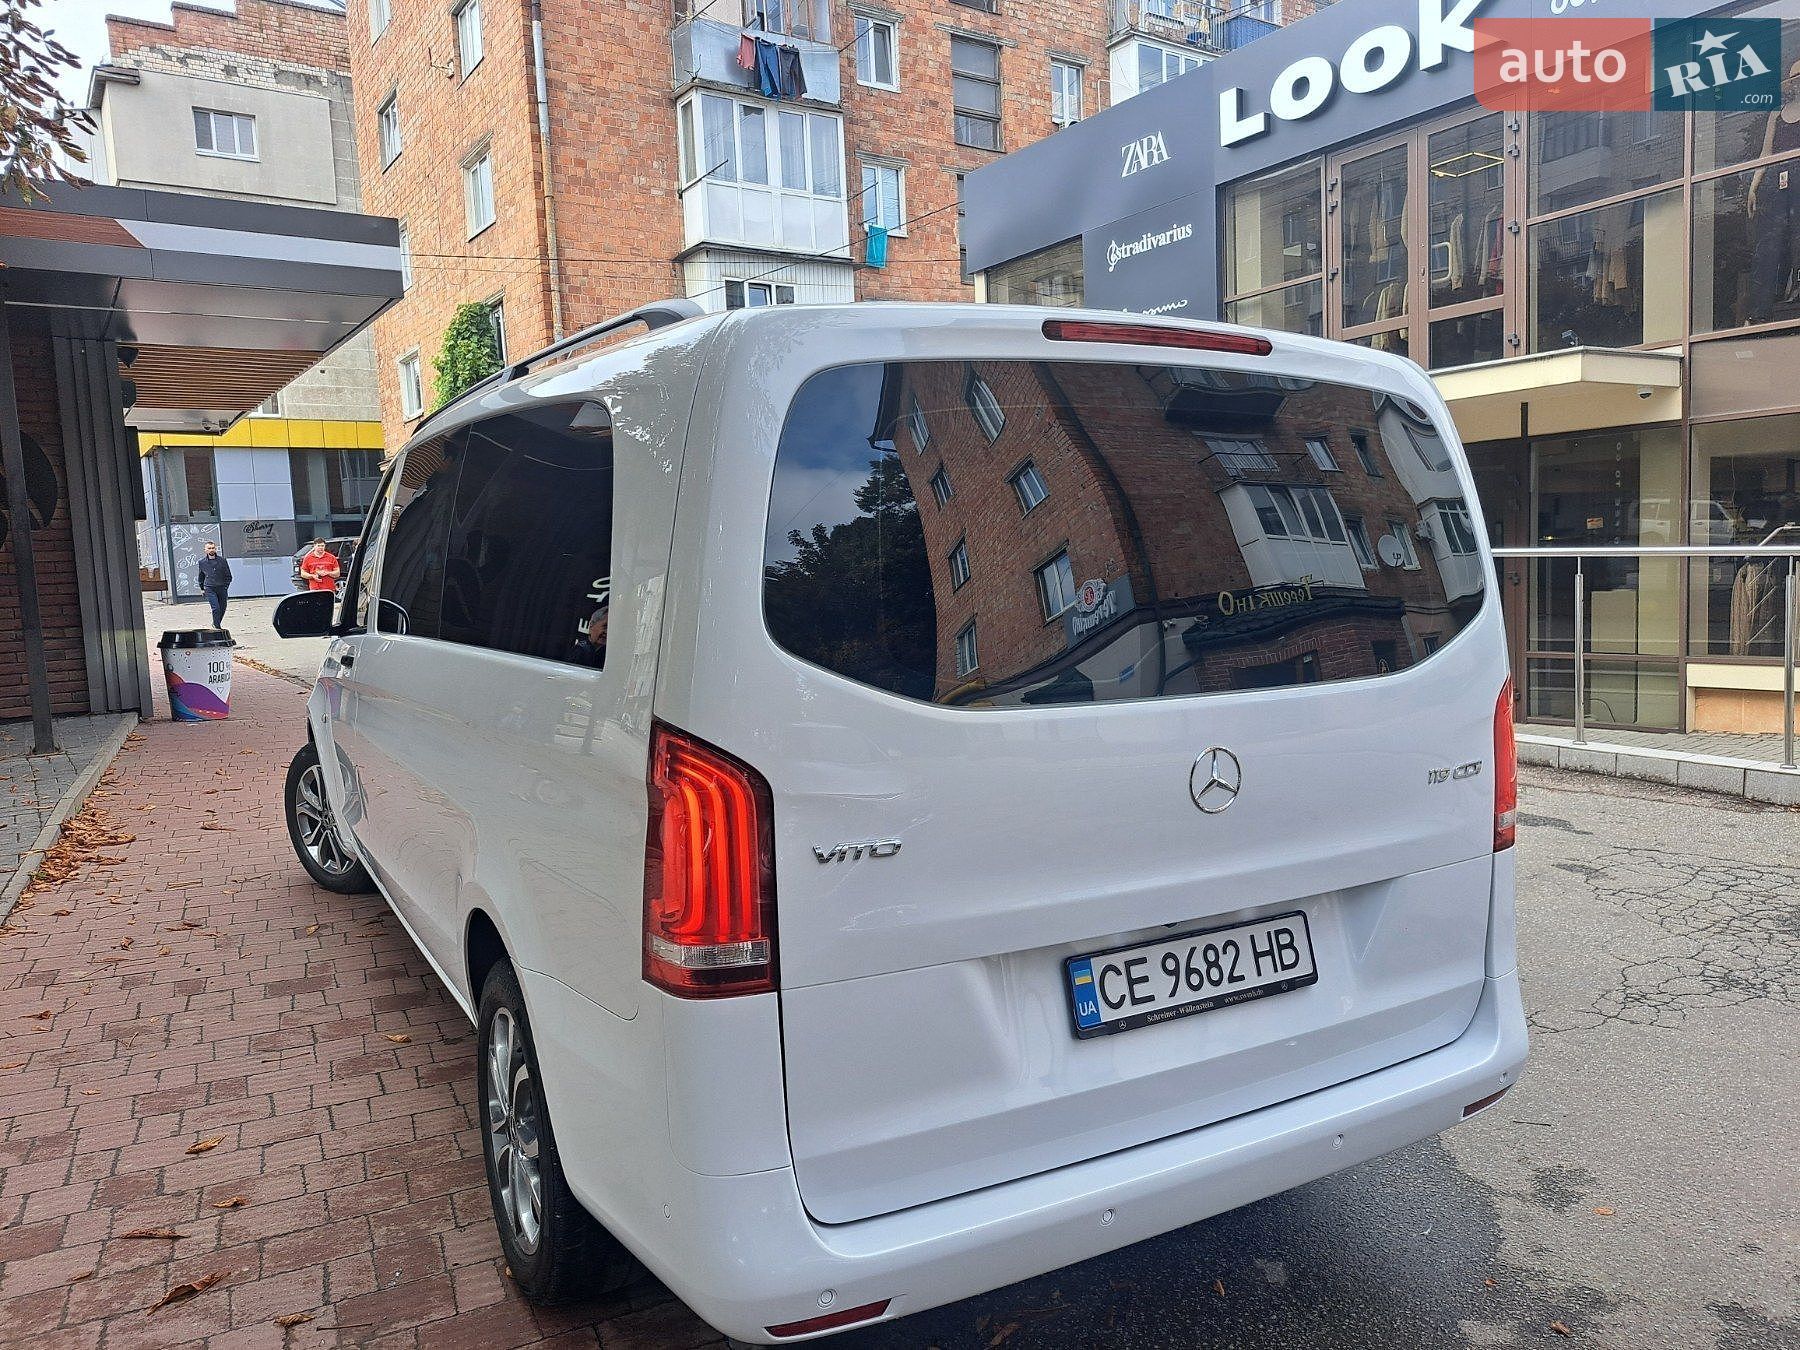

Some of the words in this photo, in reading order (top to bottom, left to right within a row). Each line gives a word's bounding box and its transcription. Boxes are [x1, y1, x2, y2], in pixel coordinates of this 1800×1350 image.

[1219, 0, 1500, 147] LOOK
[1121, 130, 1172, 178] ZARA
[812, 839, 902, 863] VITO
[1099, 957, 1155, 1010] CE
[1161, 940, 1246, 998] 9682
[1250, 927, 1300, 977] HB
[1079, 1000, 1098, 1016] UA
